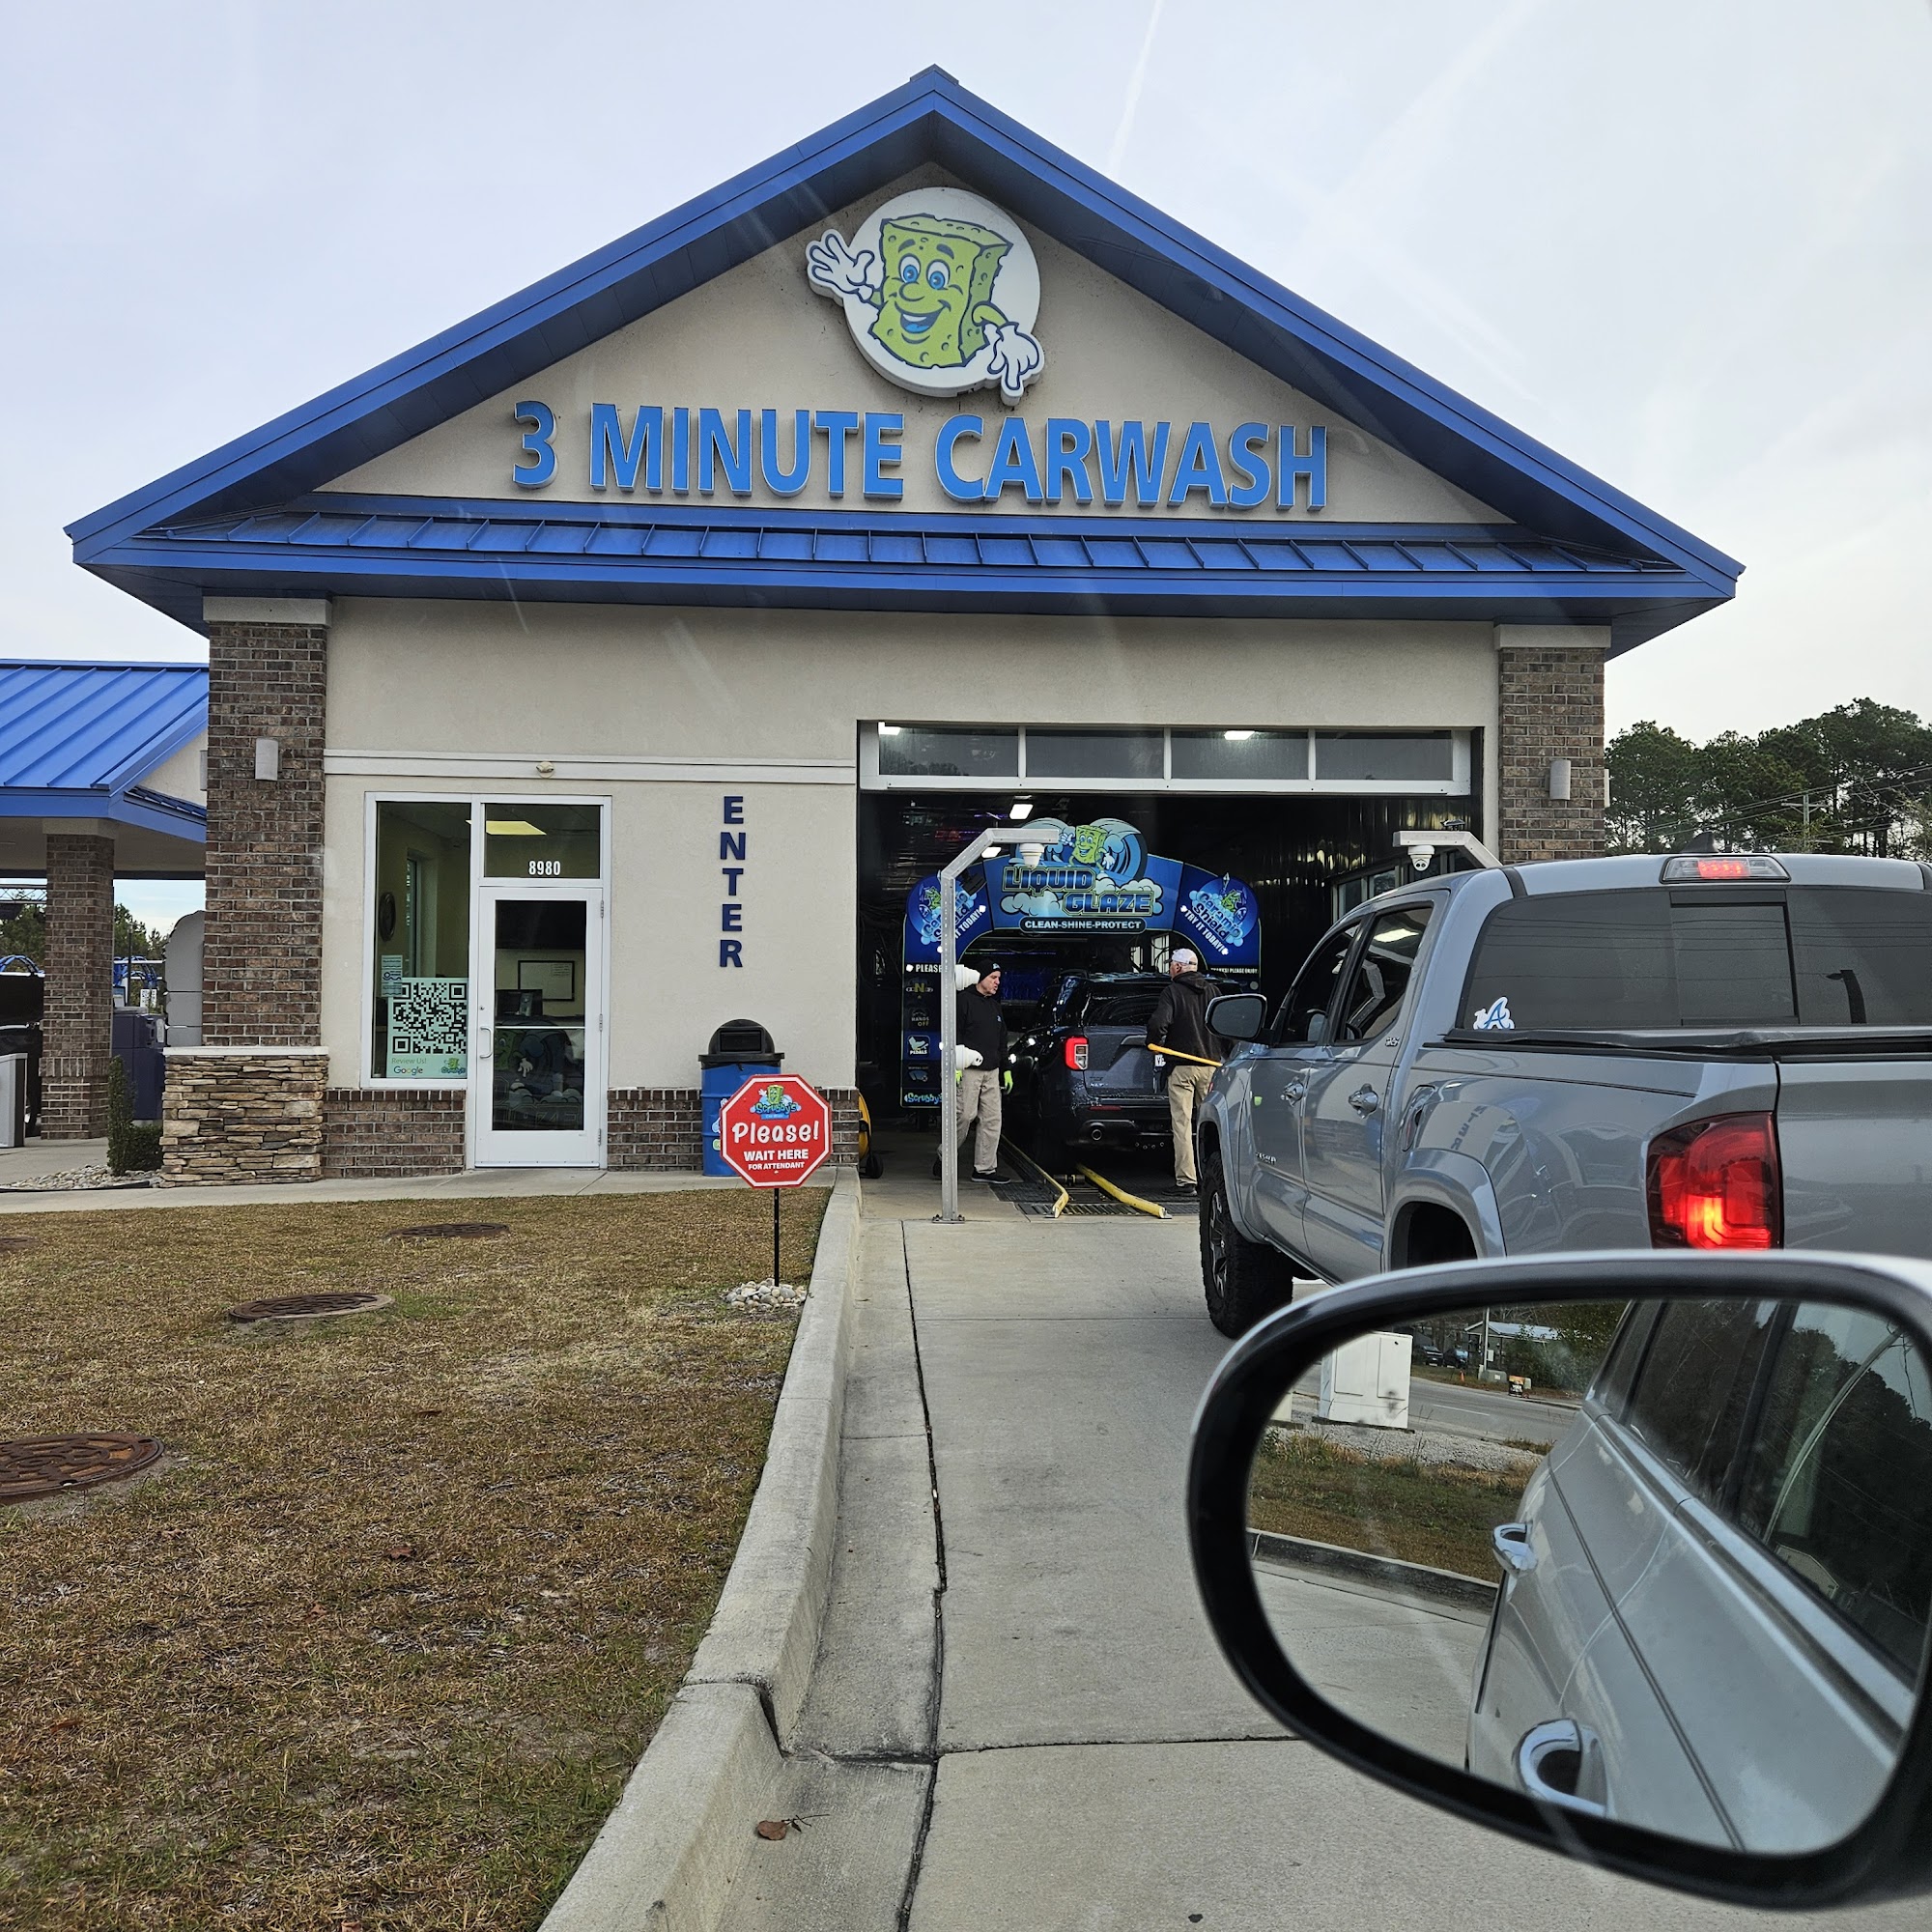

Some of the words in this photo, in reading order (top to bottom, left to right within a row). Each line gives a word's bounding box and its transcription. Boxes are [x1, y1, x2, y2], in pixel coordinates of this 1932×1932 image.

[513, 400, 558, 489] 3
[589, 402, 905, 500] MINUTE
[935, 413, 1327, 511] CARWASH
[528, 860, 561, 876] 8980
[719, 795, 747, 968] ENTER
[1003, 867, 1095, 895] LIQUID
[1064, 891, 1153, 915] GLAZE
[1024, 920, 1142, 930] CLEAN-SHINE-PROTECT
[1199, 893, 1241, 938] Ceramic
[1184, 910, 1199, 924] TRY
[1195, 921, 1206, 931] IT
[1202, 926, 1224, 952] TODAY!
[393, 1065, 423, 1076] Google
[755, 1101, 797, 1115] Scrubby's
[732, 1120, 819, 1144] Please!
[743, 1150, 776, 1161] WAIT
[777, 1149, 809, 1160] HERE
[763, 1161, 805, 1170] ATTENDANT
